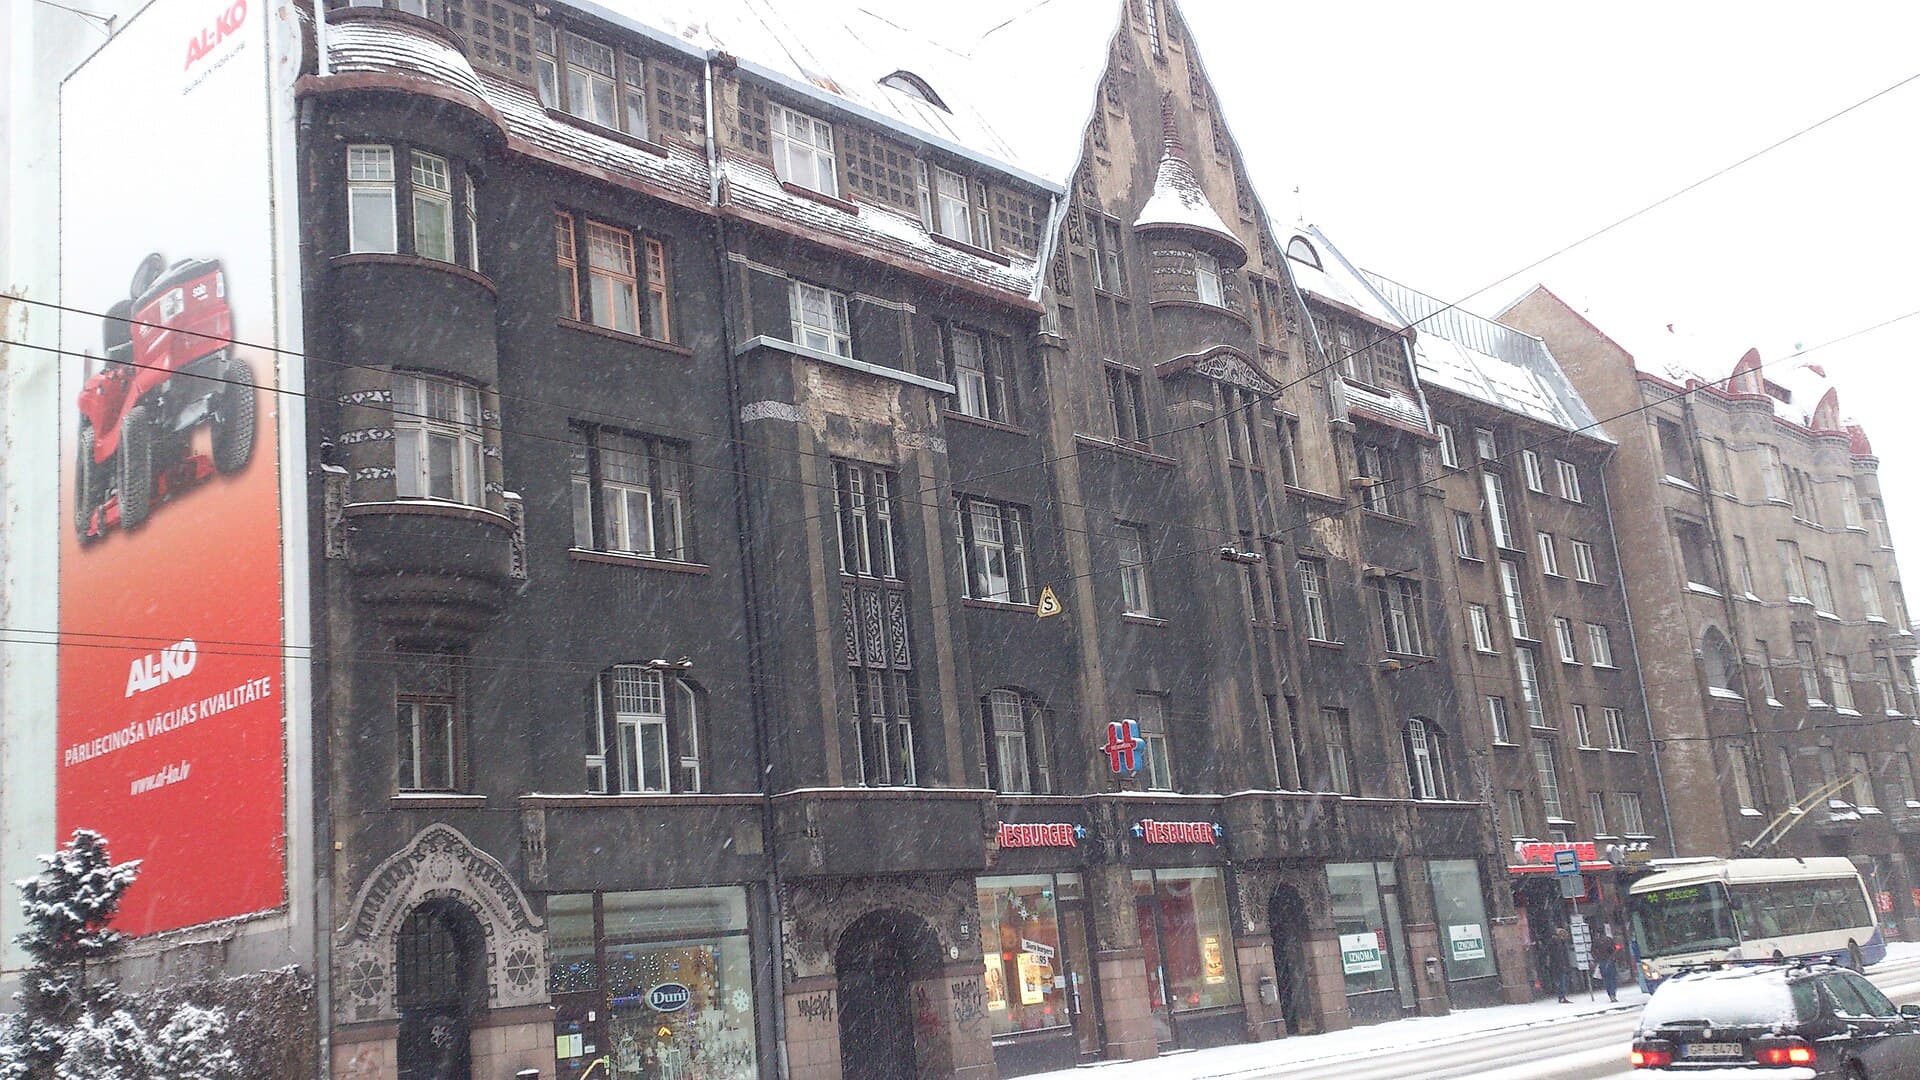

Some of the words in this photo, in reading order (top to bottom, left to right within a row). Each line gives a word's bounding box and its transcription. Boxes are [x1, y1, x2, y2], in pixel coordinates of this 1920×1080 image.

[184, 0, 247, 72] AL-KO
[1044, 596, 1053, 611] S
[125, 638, 197, 698] AL-KO
[64, 721, 145, 767] PĀRLIECINOŠA
[147, 703, 197, 738] VĀCIJAS
[200, 676, 271, 720] KVALITĀTE
[1142, 818, 1215, 846] HESBURGER
[653, 988, 687, 1005] Duni
